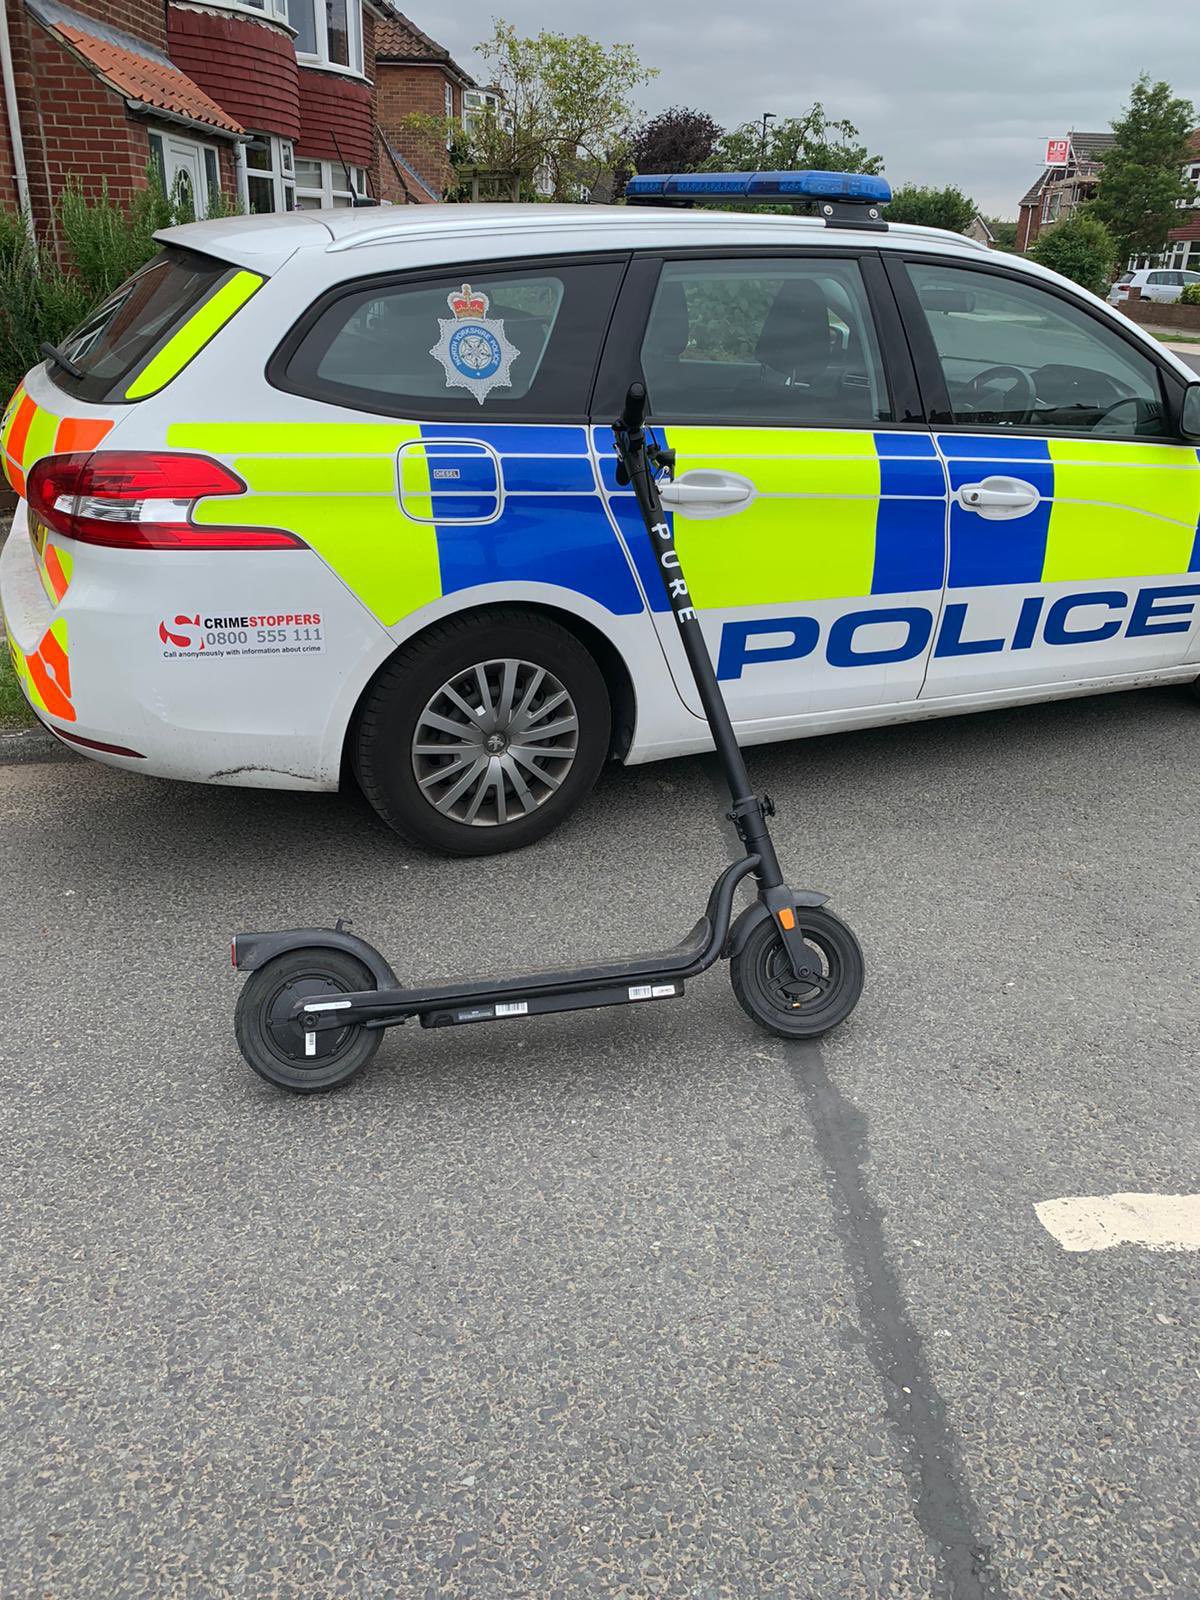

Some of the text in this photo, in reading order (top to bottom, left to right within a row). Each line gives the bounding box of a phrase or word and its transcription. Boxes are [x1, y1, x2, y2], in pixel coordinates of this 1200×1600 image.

[1050, 142, 1066, 150] JD
[451, 327, 500, 366] NORTH YORKSHIRE POLICE
[651, 522, 697, 624] PURE
[204, 613, 321, 630] CRIMESTOPPERS
[206, 628, 323, 646] 0800 555 111
[716, 584, 1200, 681] POLICE
[178, 650, 225, 659] anonymously
[241, 647, 281, 655] information
